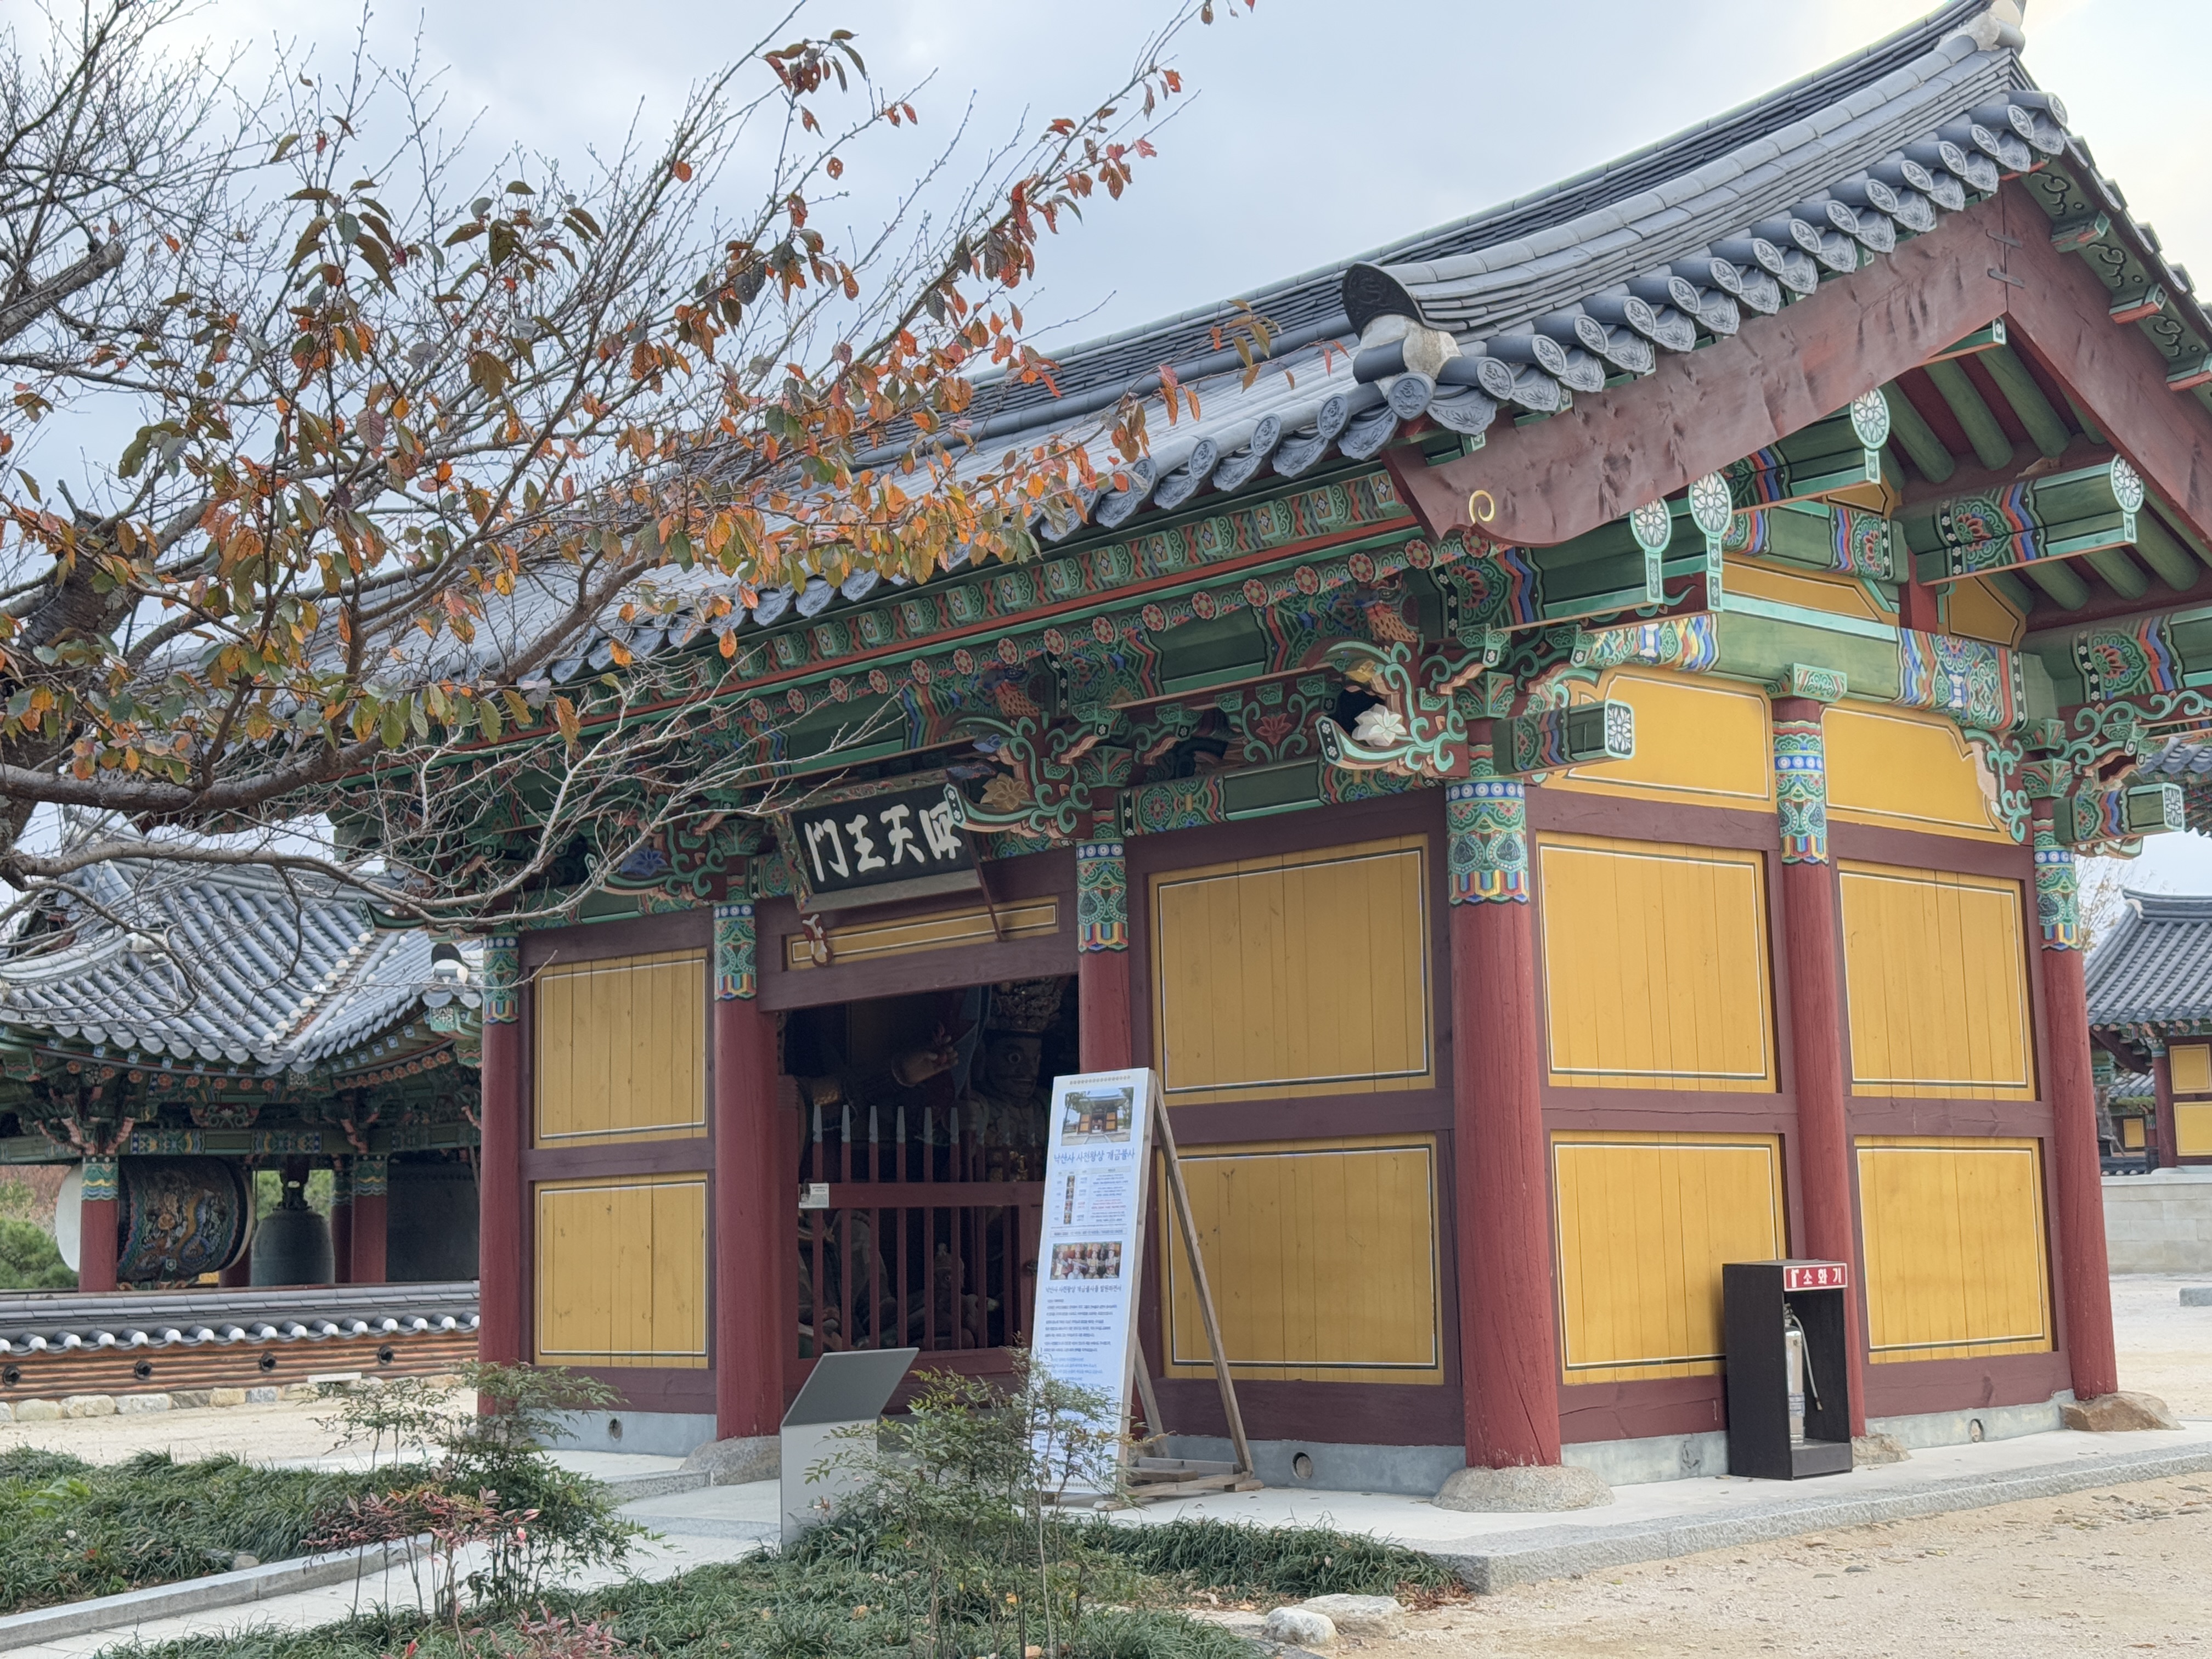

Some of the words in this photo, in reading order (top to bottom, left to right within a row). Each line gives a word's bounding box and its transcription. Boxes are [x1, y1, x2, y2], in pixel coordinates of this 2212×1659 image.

[1054, 1152, 1075, 1164] 낙산사
[1076, 1149, 1105, 1163] 사천왕상
[1106, 1147, 1135, 1161] 개금불사
[1803, 1267, 1842, 1285] 소화기
